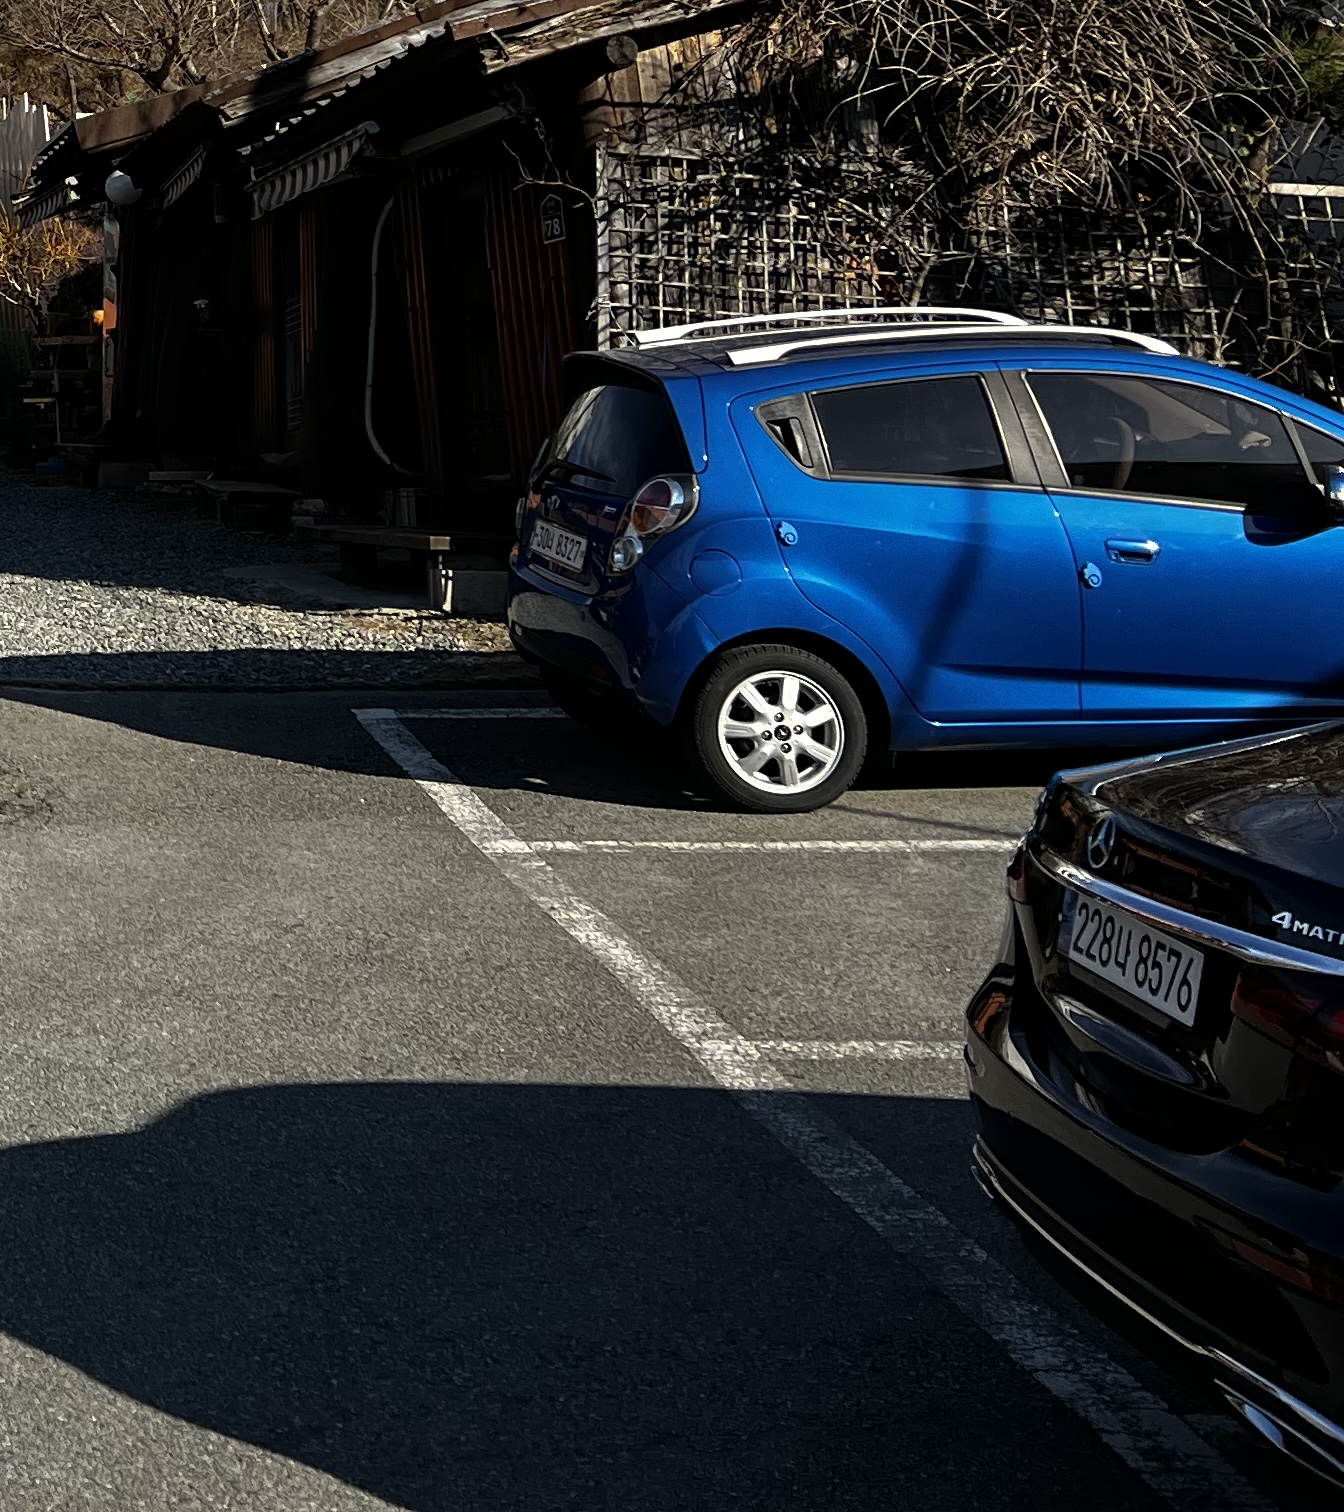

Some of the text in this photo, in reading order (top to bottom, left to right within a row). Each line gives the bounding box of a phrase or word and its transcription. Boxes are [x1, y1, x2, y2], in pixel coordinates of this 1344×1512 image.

[544, 218, 561, 238] 78
[555, 533, 582, 563] 8327
[1073, 902, 1194, 1013] 228나 8576
